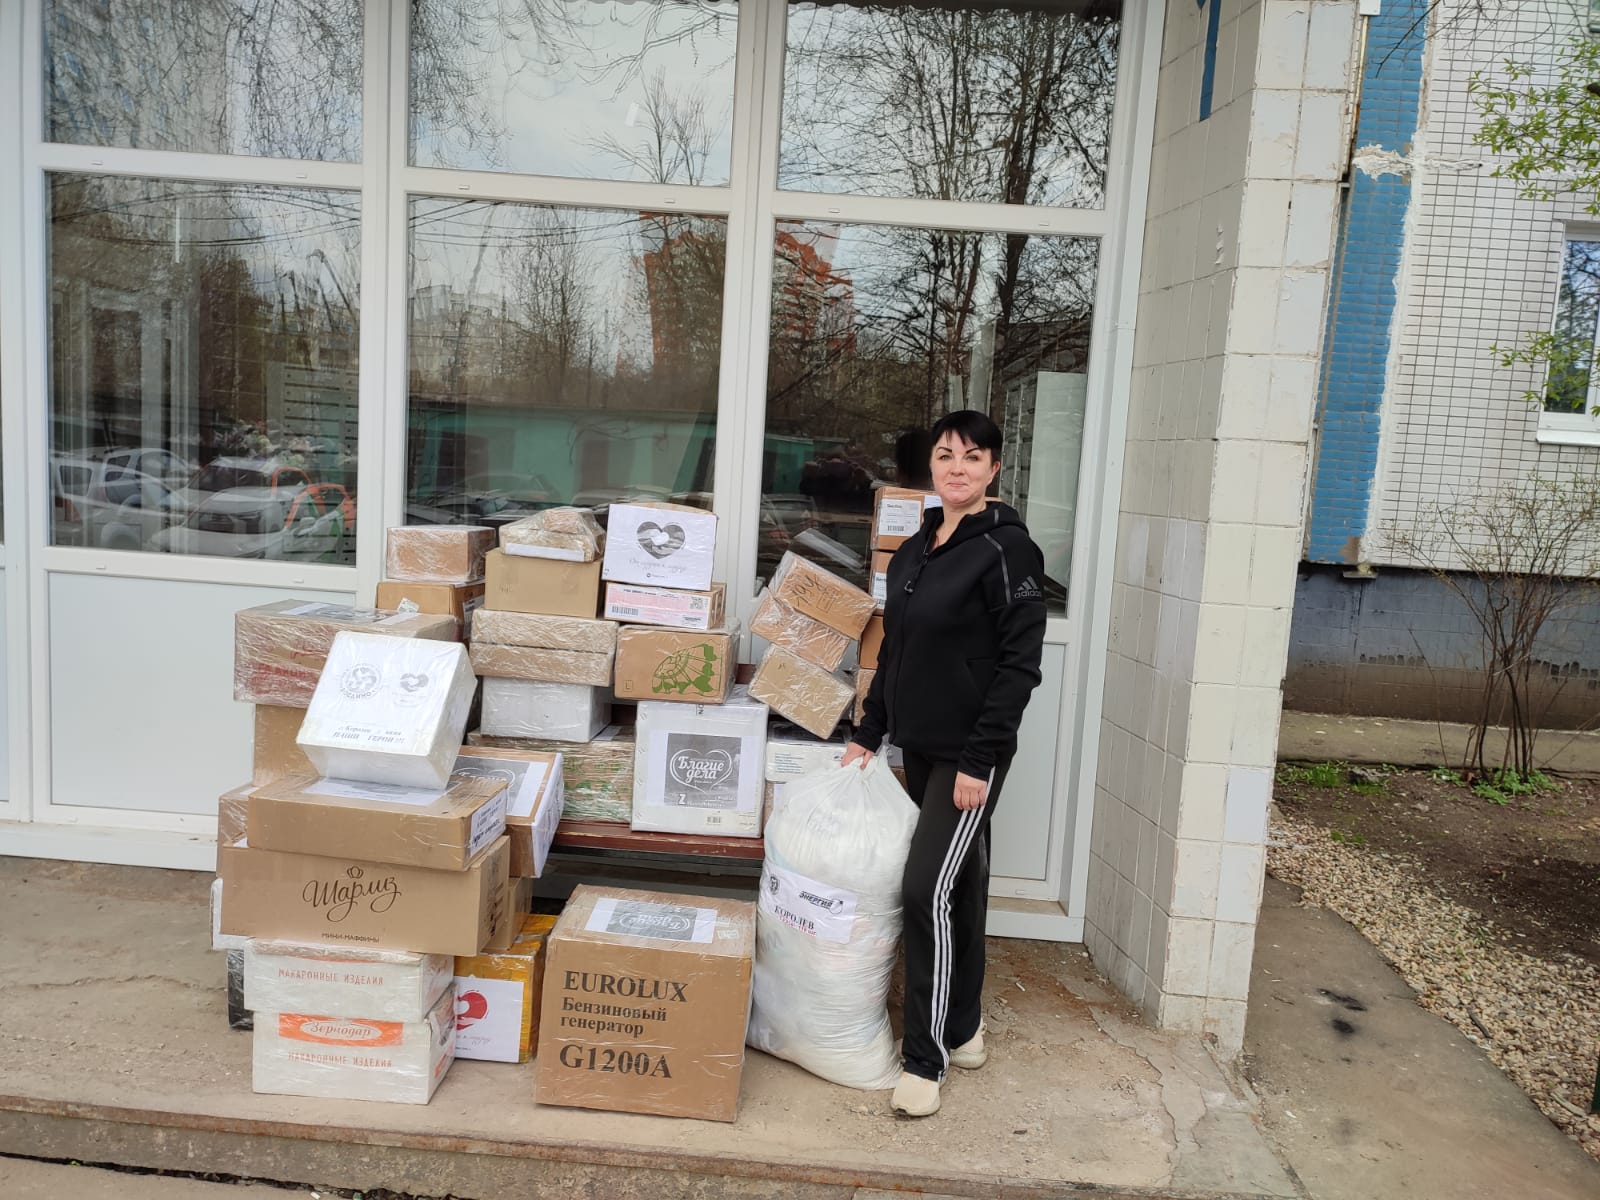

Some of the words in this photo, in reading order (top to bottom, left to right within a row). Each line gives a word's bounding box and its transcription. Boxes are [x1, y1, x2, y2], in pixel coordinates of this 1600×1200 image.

[1014, 590, 1042, 599] adidas
[678, 756, 725, 772] Благие
[685, 769, 718, 783] дела
[799, 891, 834, 909] ЭНЕРГИЯ
[774, 905, 815, 930] КОРОЛЕВ
[278, 967, 338, 982] МАКАРОННЫЕ
[344, 975, 384, 985] ИЗДЕЛИЯ
[563, 970, 688, 1002] EUROLUX
[562, 996, 667, 1021] Бензиновый
[310, 1022, 372, 1039] Зернодар
[560, 1016, 644, 1038] генератор
[288, 1051, 347, 1065] МАКАРОННЫЕ
[352, 1057, 392, 1068] ИЗДЕЛИЯ
[560, 1044, 672, 1078] G1200A
